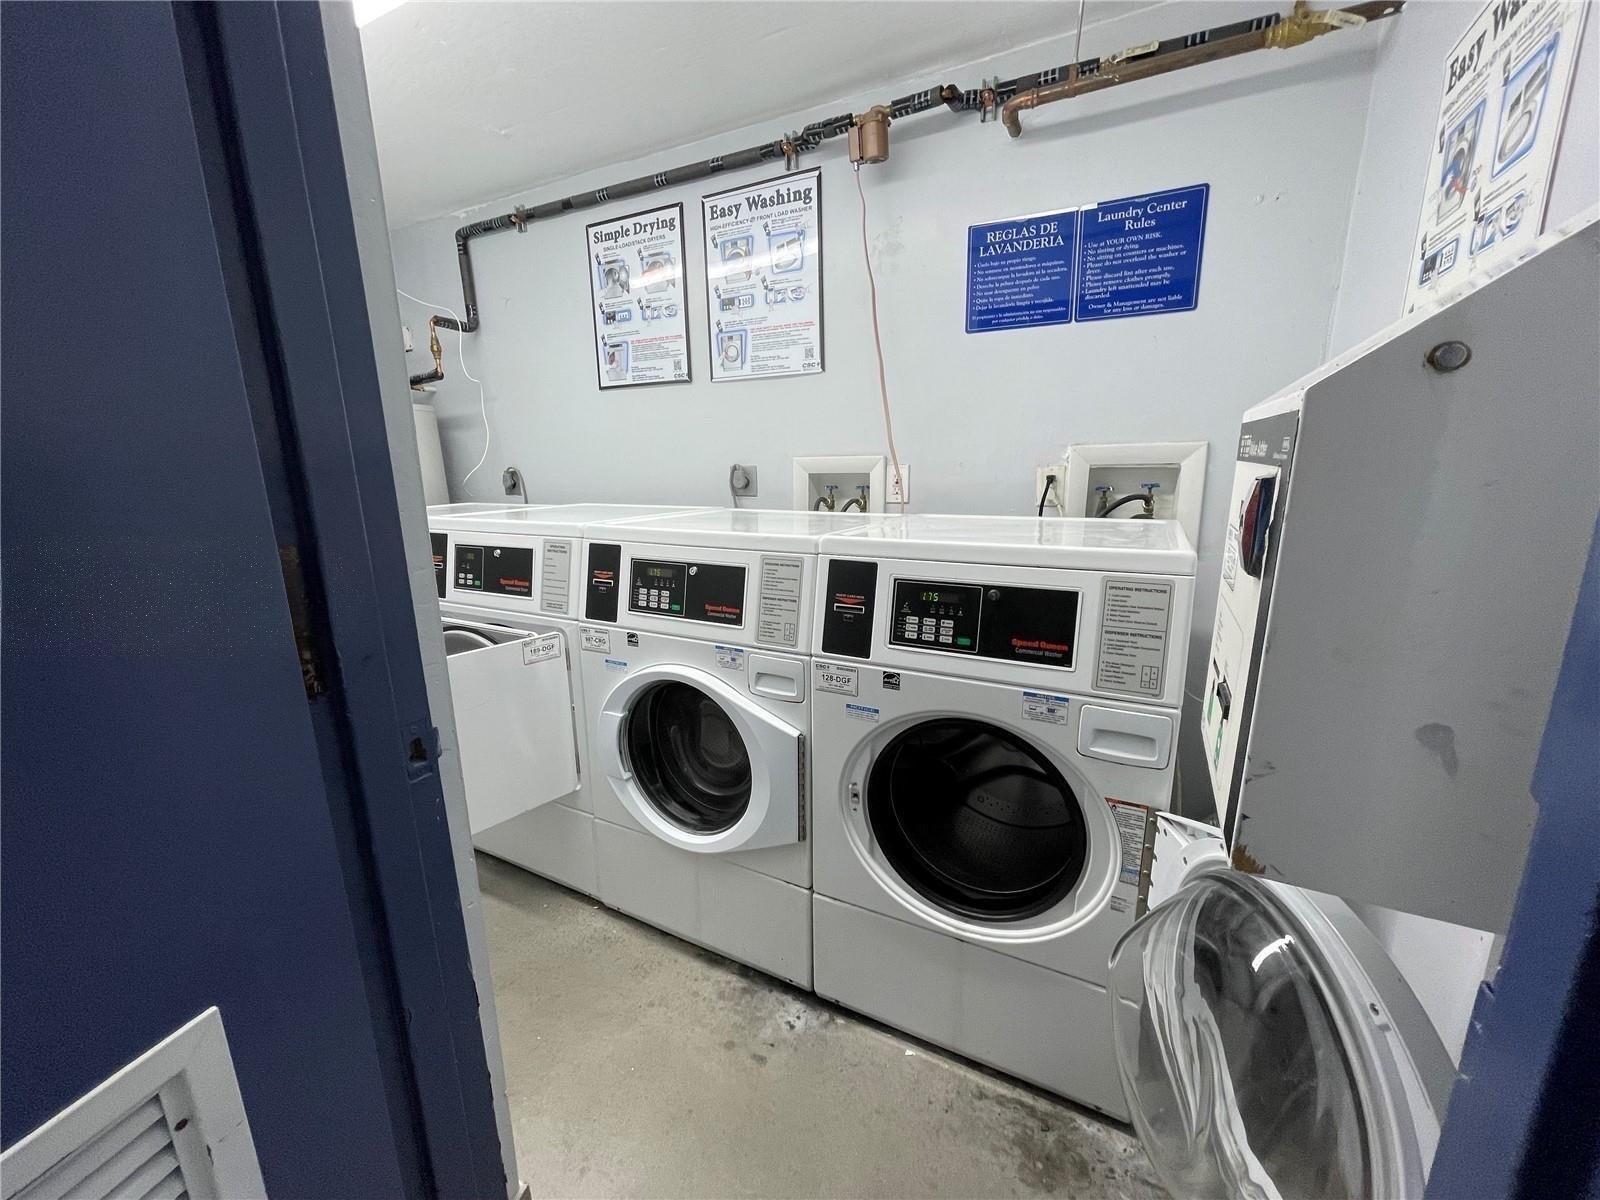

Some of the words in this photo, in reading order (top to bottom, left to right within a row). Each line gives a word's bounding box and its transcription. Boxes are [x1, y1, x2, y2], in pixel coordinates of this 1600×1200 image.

[1446, 29, 1487, 96] Easy
[709, 203, 742, 221] Easy
[745, 187, 812, 212] Washing
[756, 213, 774, 222] FRONT
[774, 210, 789, 219] LOAD
[790, 205, 813, 216] WASHER
[1097, 206, 1144, 223] Laundry
[1147, 200, 1188, 214] Center
[593, 225, 630, 244] Simple
[633, 217, 676, 236] Drying
[1125, 217, 1156, 231] Rules
[647, 234, 666, 244] DRYERS
[987, 225, 1036, 243] REGLAS
[1040, 221, 1058, 235] DE
[979, 235, 1064, 257] LAVANDERIA
[1106, 237, 1125, 247] YOUR
[1126, 234, 1144, 243] OWN
[1123, 249, 1147, 257] counters
[1123, 255, 1147, 264] overload
[1158, 251, 1178, 259] washer
[1103, 270, 1123, 279] discard
[1134, 267, 1148, 275] after
[1124, 275, 1144, 283] clothes
[1085, 287, 1108, 295] Laundry
[1118, 282, 1149, 290] unattended
[1150, 279, 1163, 287] may
[1113, 299, 1147, 308] Management
[1167, 293, 1183, 301] liable
[1011, 638, 1039, 649] Speed
[1040, 641, 1069, 652] Queen
[1015, 647, 1044, 656] Commercial
[822, 674, 852, 684] 128-DGF
